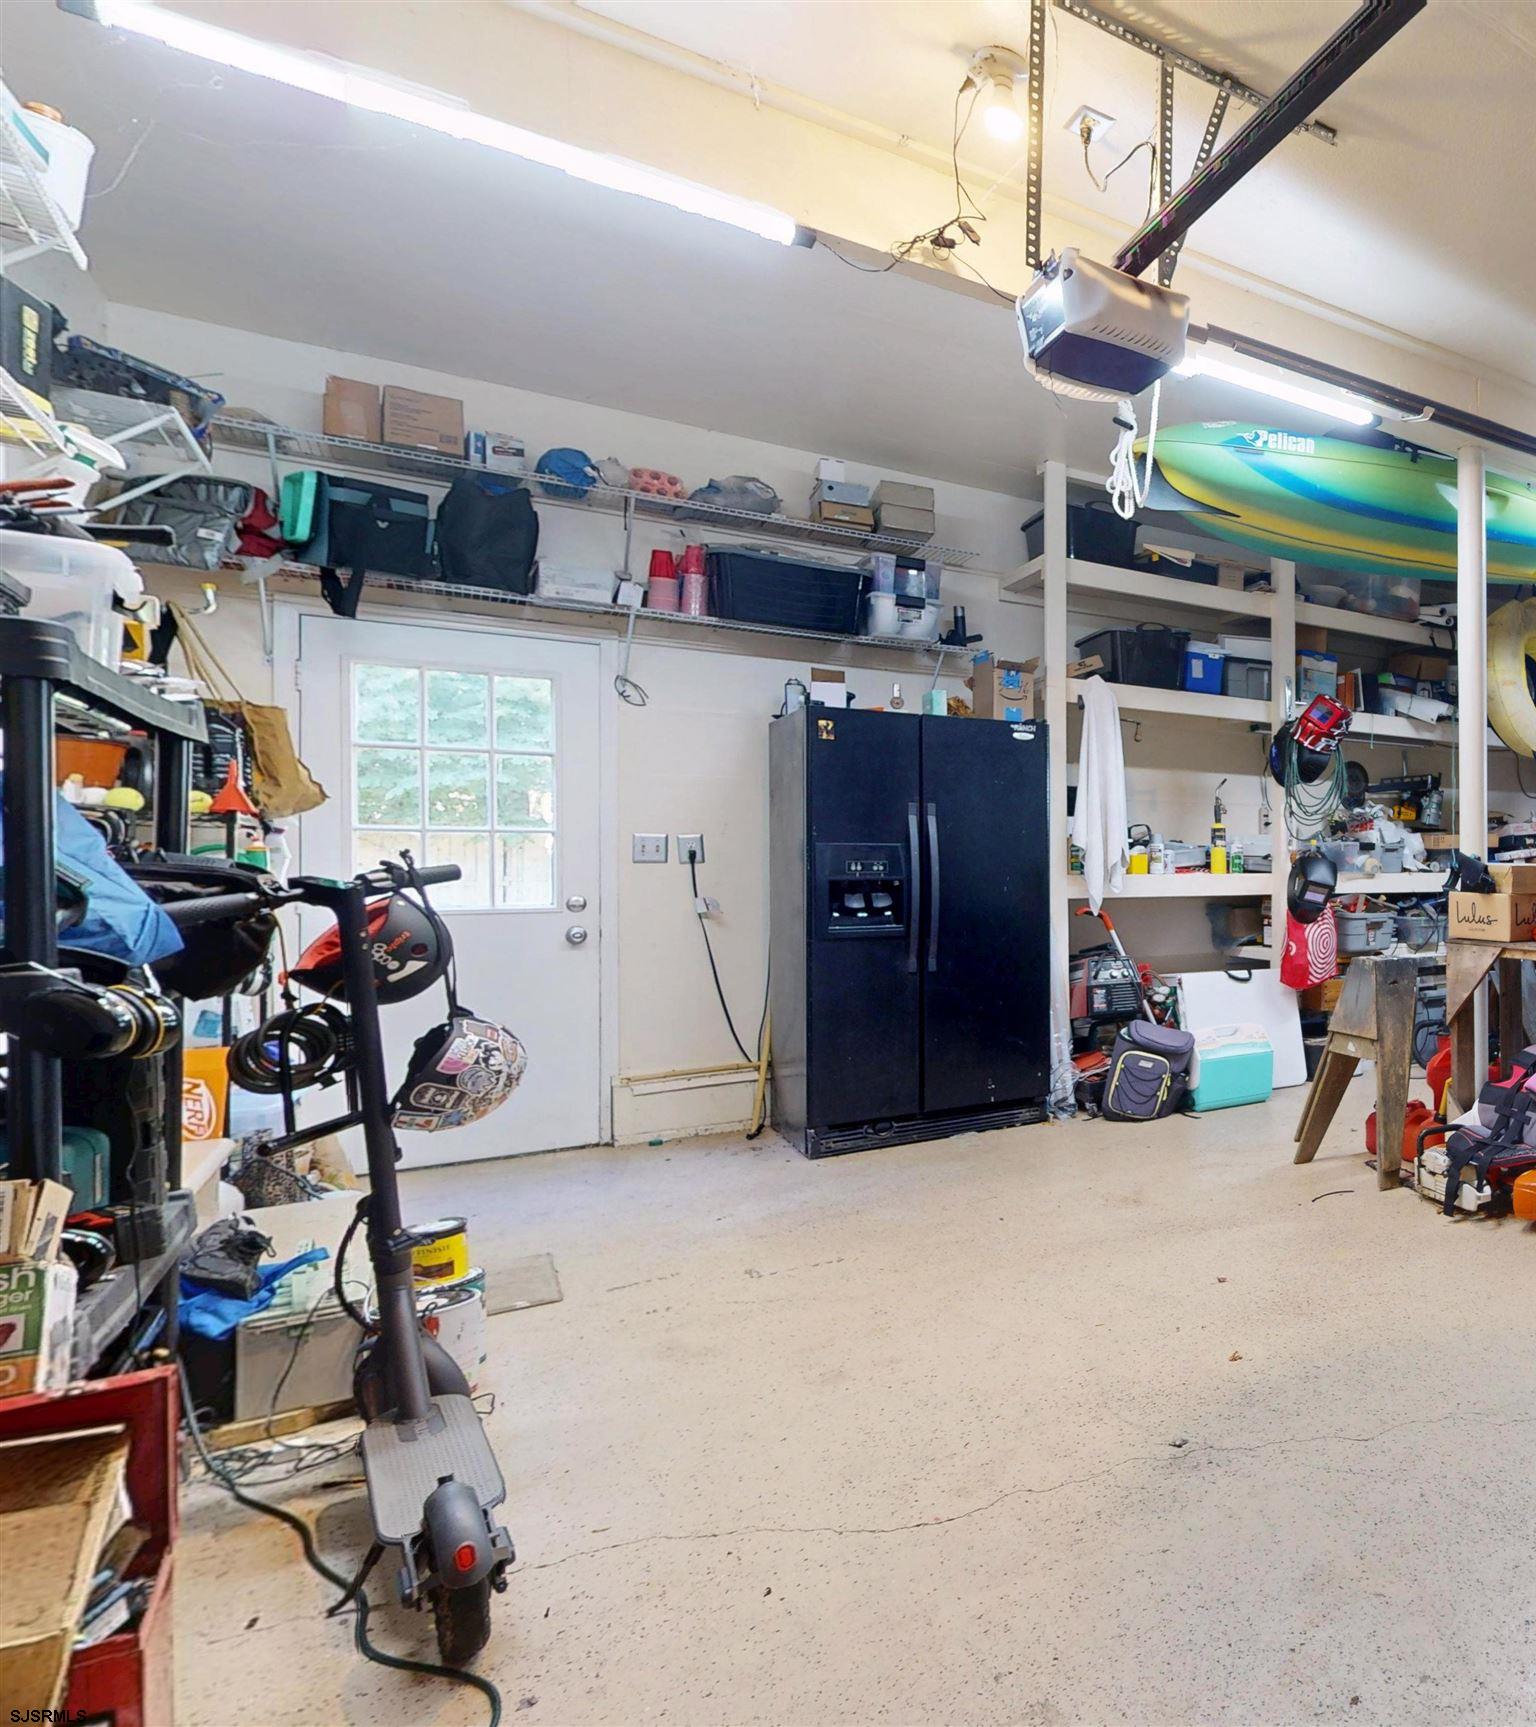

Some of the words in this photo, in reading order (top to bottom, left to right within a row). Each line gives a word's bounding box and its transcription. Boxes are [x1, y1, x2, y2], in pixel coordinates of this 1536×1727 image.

[1256, 429, 1315, 454] Pelican
[1456, 901, 1498, 926] Lulus
[182, 1078, 209, 1137] NERF
